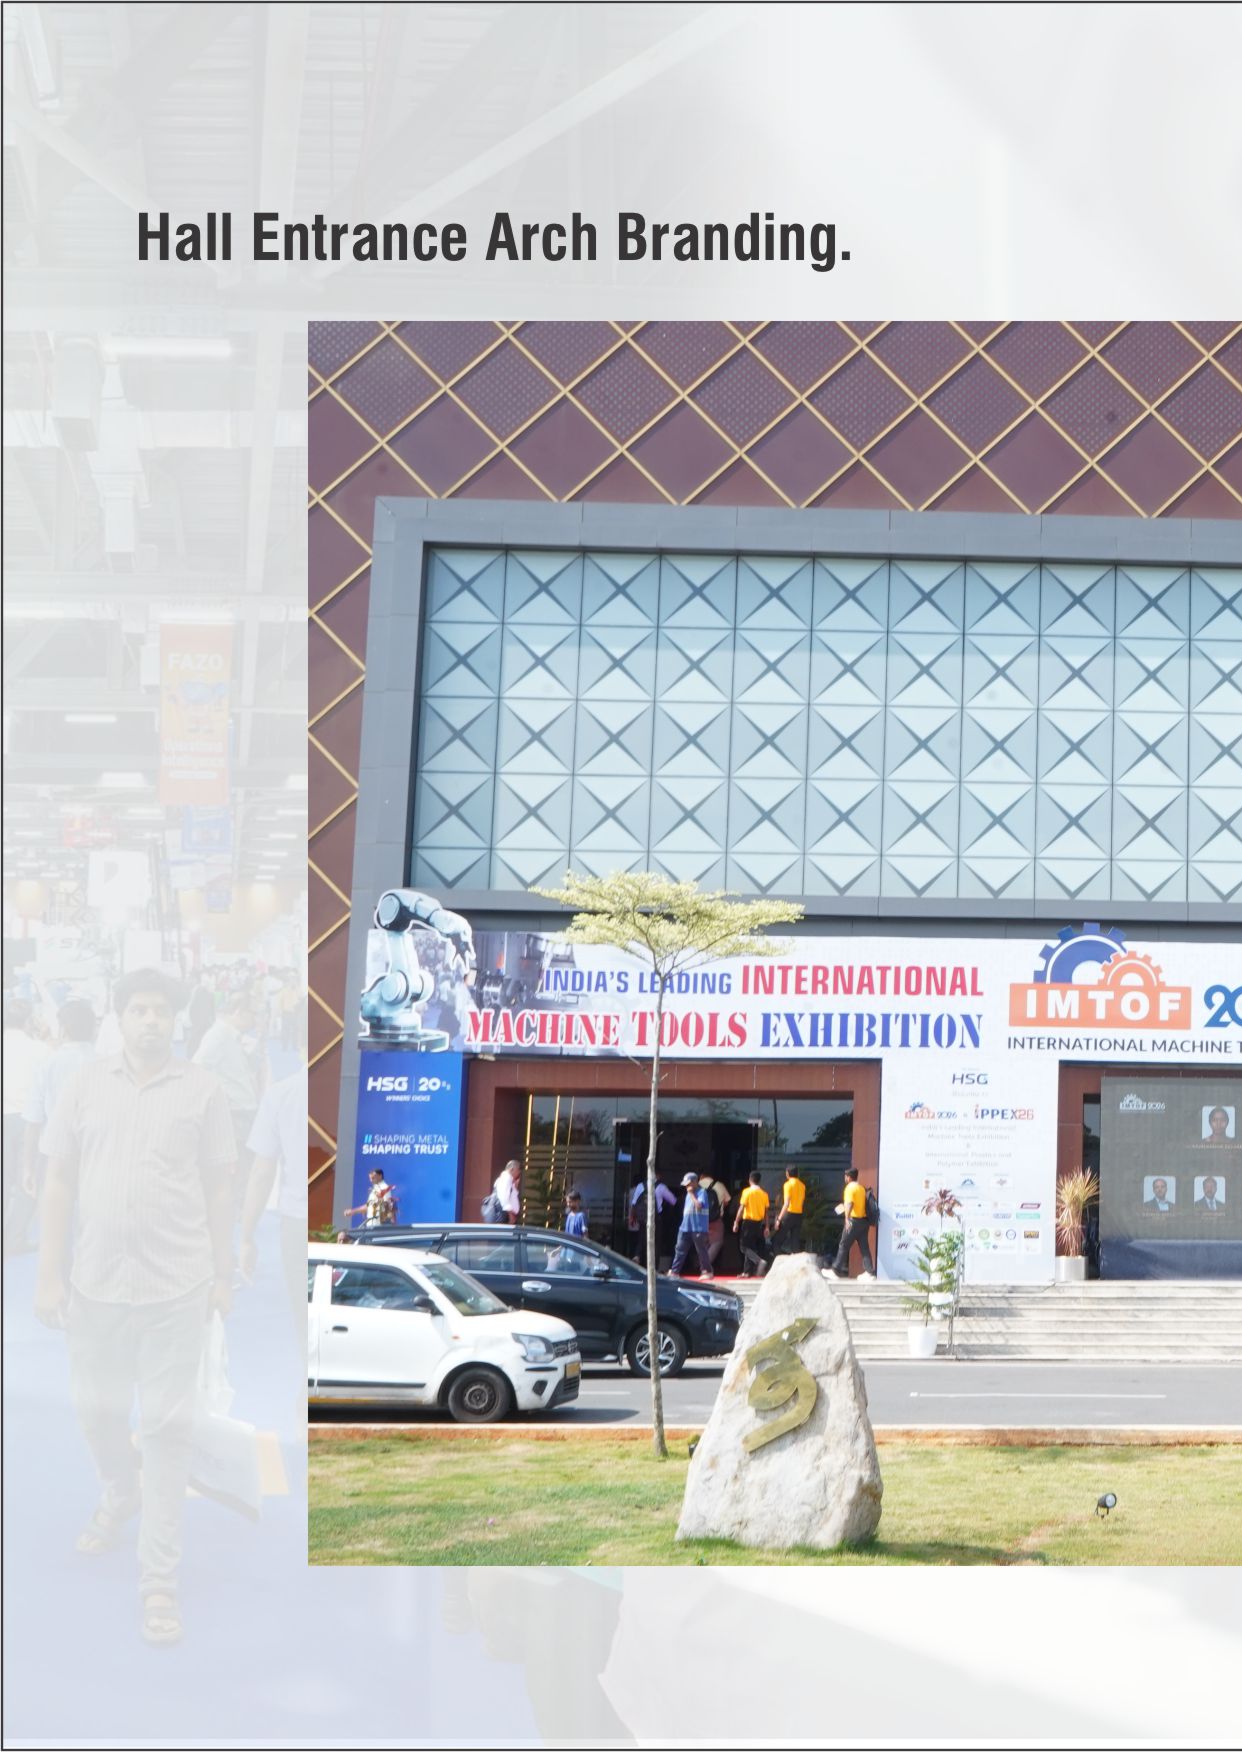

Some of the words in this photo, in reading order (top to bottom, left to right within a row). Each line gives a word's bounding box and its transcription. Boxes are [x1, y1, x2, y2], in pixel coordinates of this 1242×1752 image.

[168, 653, 224, 673] FAZO
[544, 969, 629, 994] INDIA'S
[638, 970, 732, 995] LEADING
[741, 964, 985, 997] INTERNATIONAL
[1025, 988, 1182, 1022] IMTOF
[465, 1011, 621, 1047] MACHINE
[631, 1010, 748, 1048] TOOLS
[759, 1011, 983, 1049] EXHIBITION
[1007, 1036, 1147, 1053] INTERNATIONAL
[1151, 1038, 1233, 1054] MACHINE
[366, 1076, 409, 1092] HSG
[418, 1077, 441, 1091] 20
[951, 1073, 988, 1085] HSG
[374, 1135, 415, 1144] SHAPING
[418, 1135, 448, 1144] METAL
[362, 1144, 410, 1154] SHAPING
[414, 1144, 449, 1155] TRUST
